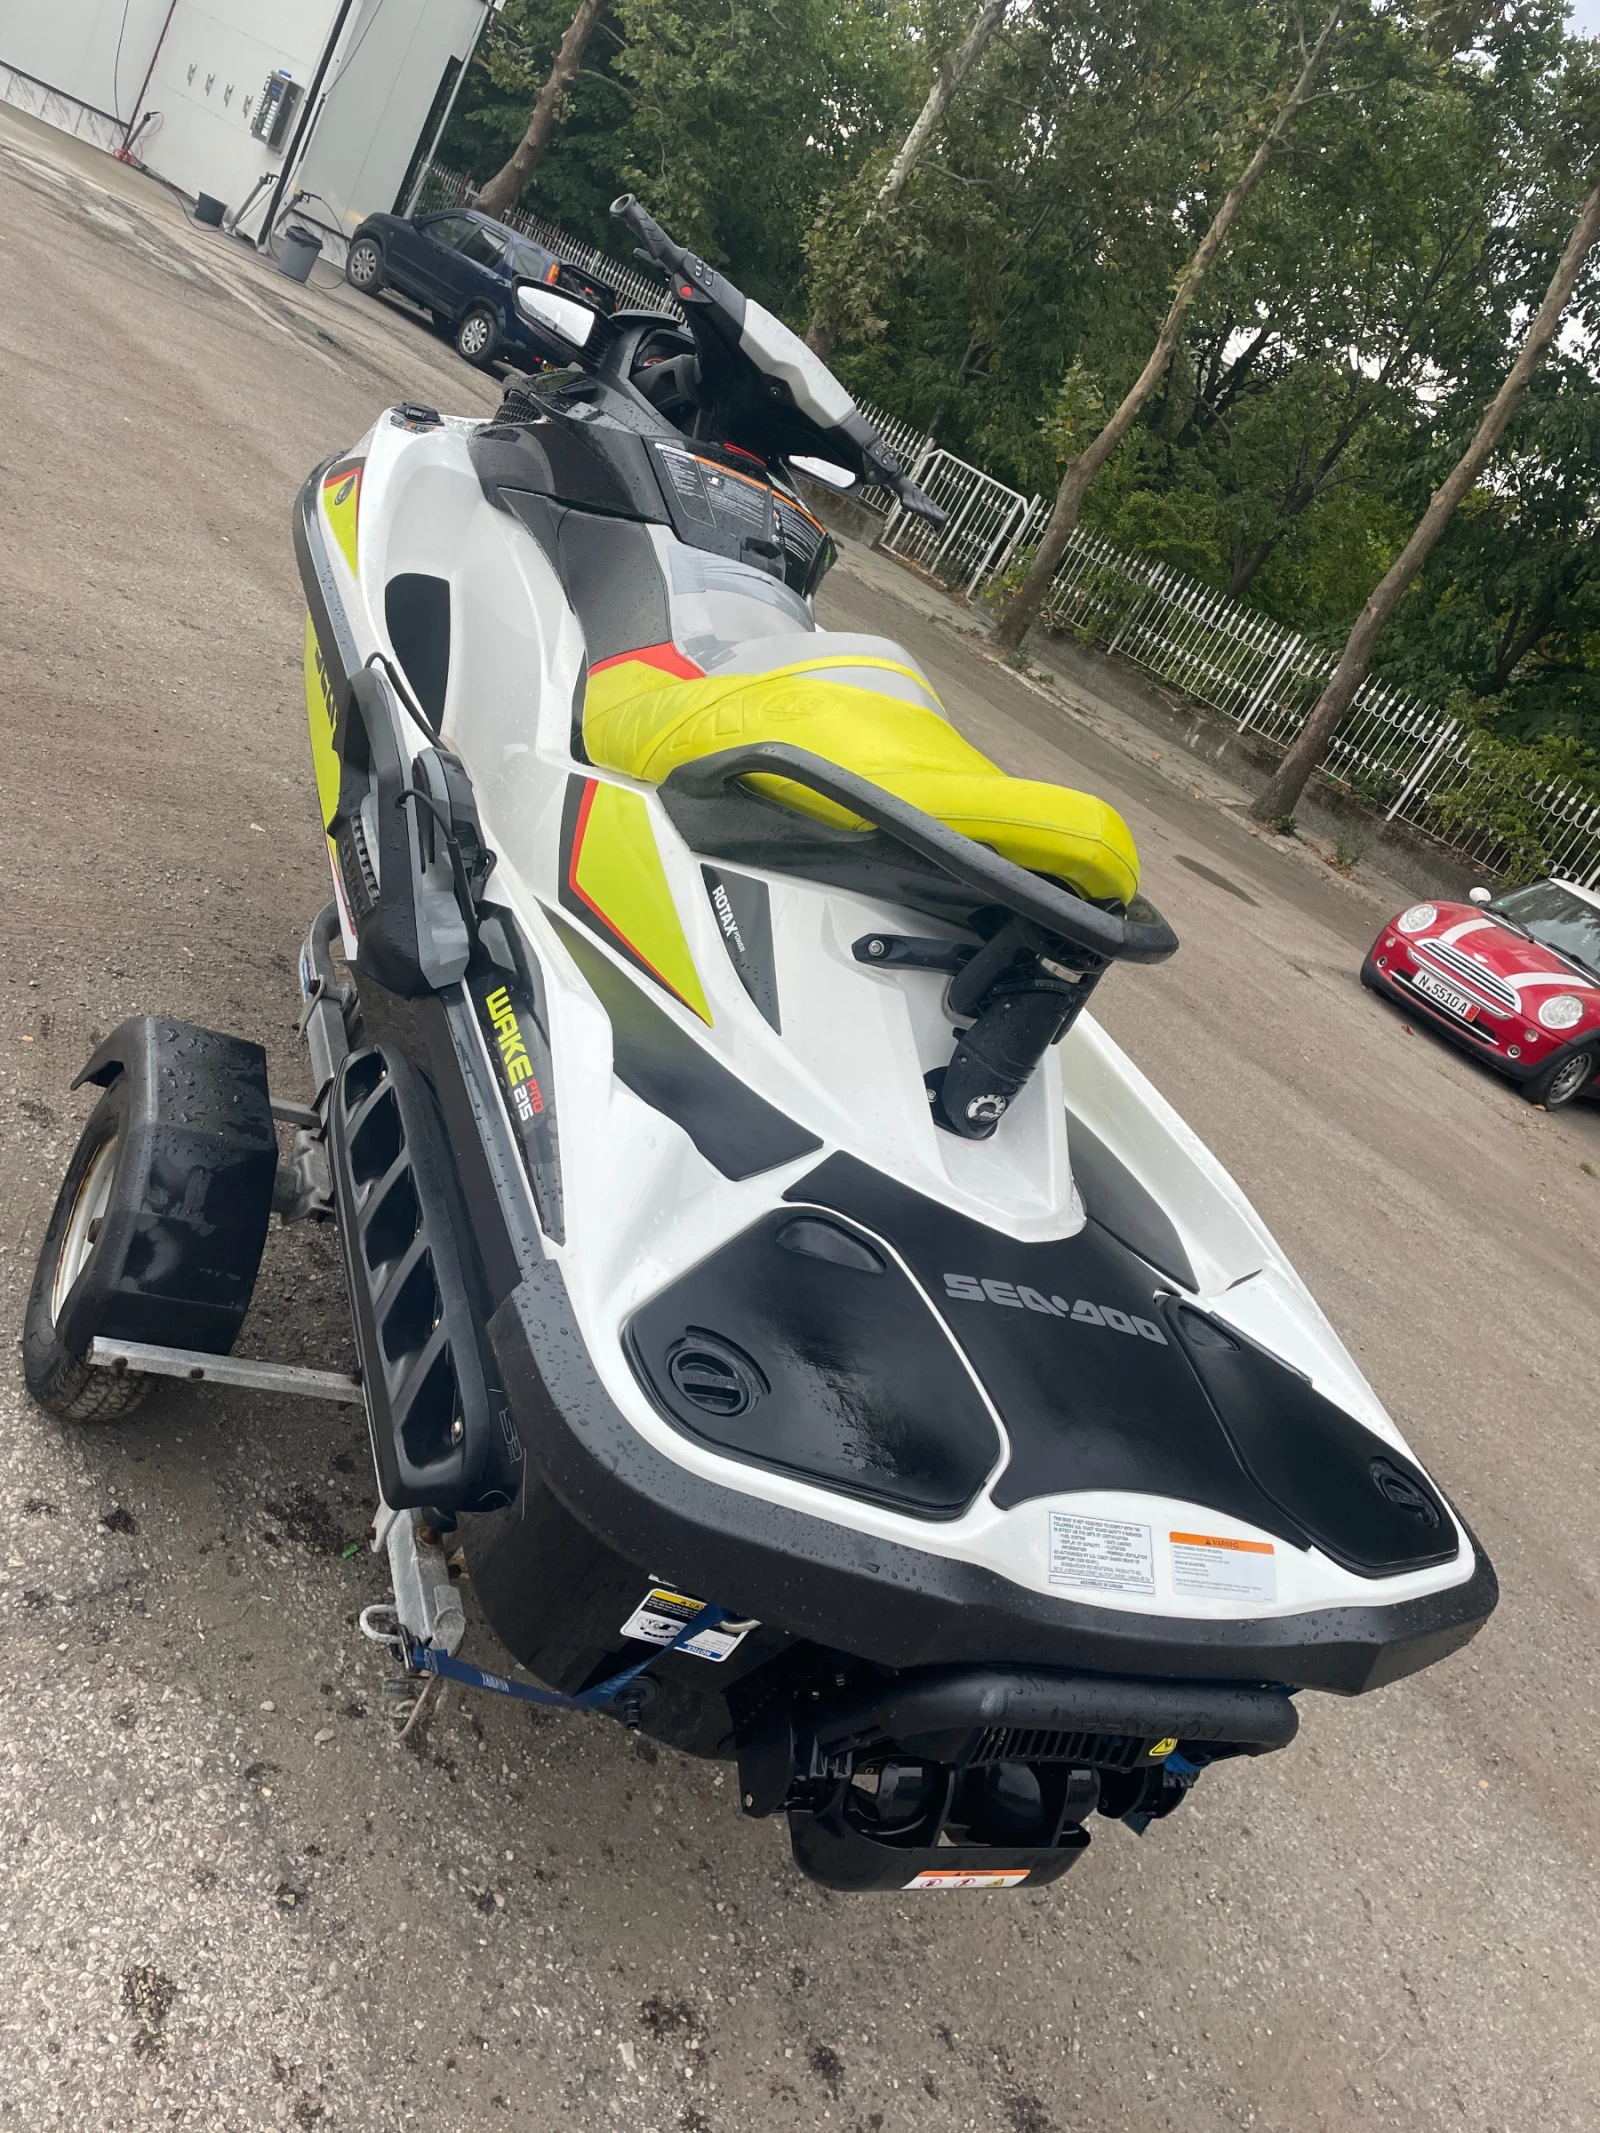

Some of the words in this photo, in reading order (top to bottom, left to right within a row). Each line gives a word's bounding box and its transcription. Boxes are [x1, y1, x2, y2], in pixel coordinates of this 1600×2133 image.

[712, 884, 738, 938] ROTAX
[733, 930, 746, 953] POWER
[486, 986, 533, 1086] WAKE
[513, 1085, 534, 1121] 215
[526, 1078, 544, 1114] PRO
[1211, 1539, 1239, 1549] WARNING
